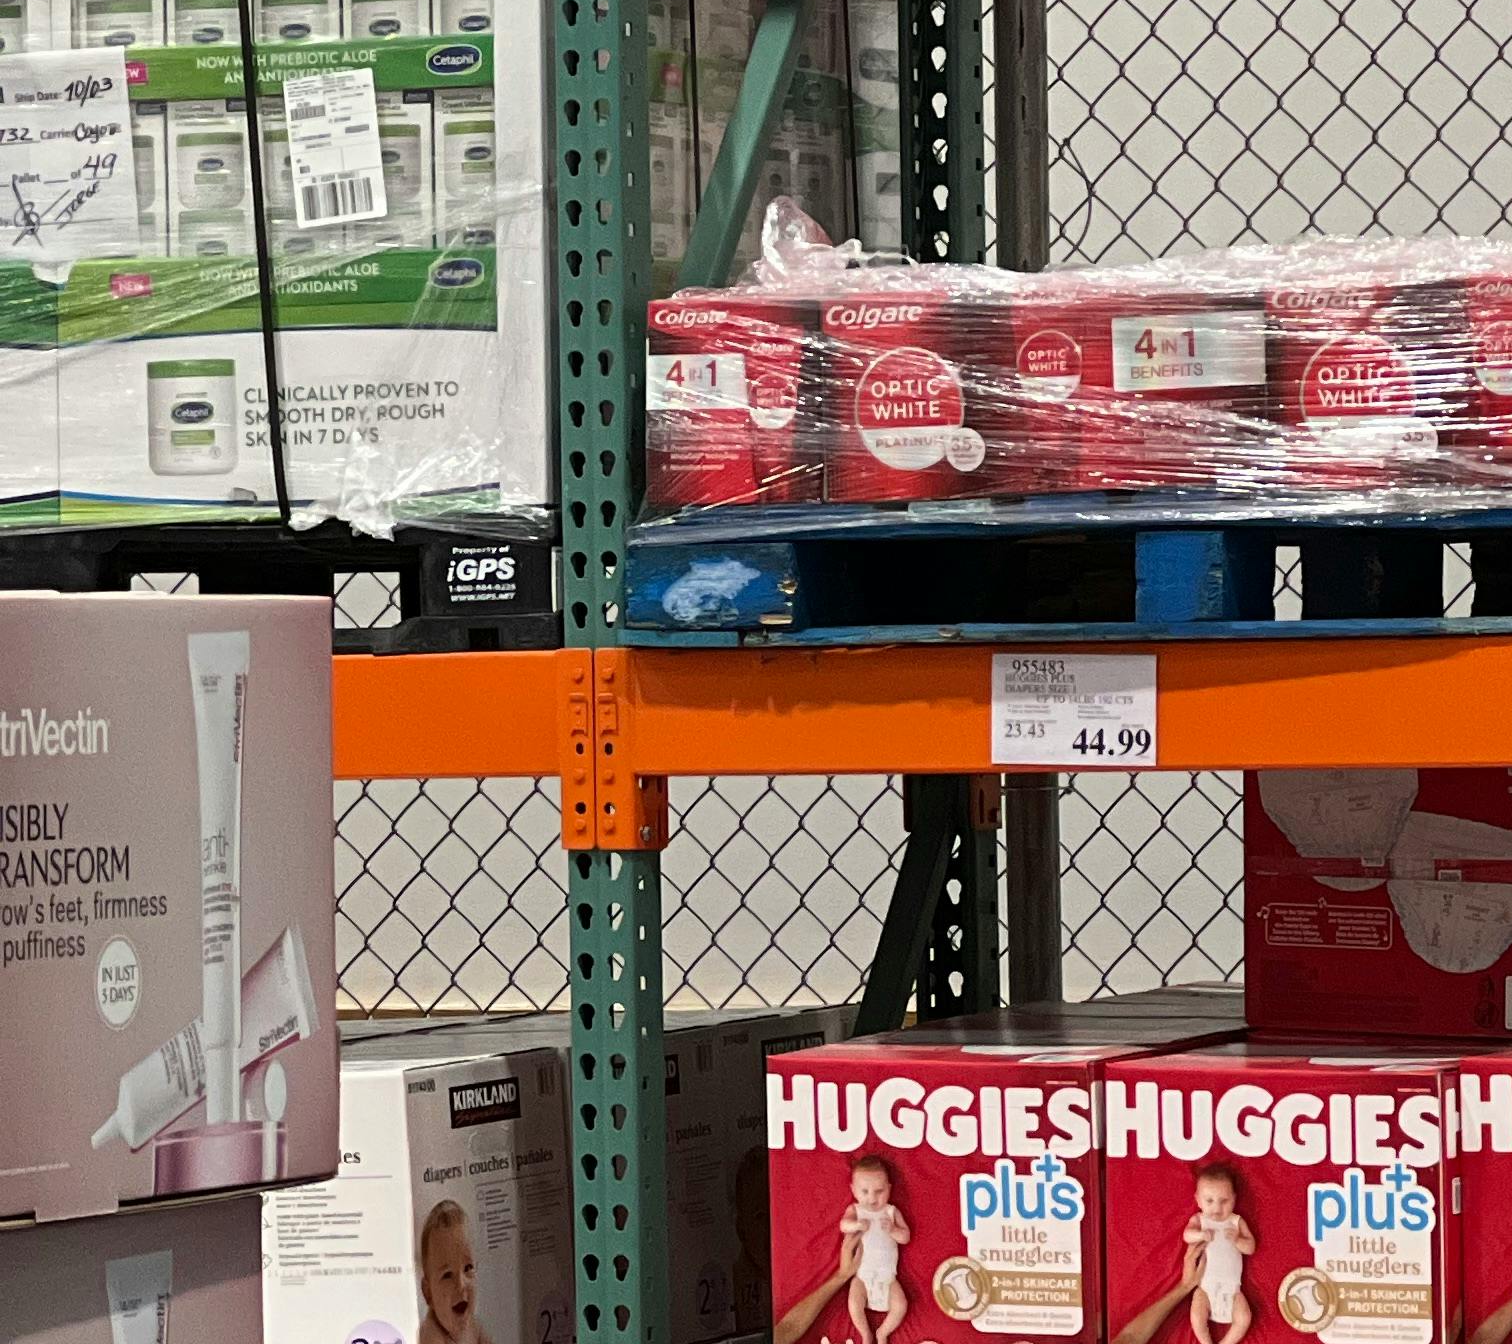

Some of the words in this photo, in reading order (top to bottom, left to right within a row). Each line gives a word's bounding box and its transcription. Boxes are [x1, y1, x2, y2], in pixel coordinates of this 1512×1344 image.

[196, 58, 230, 68] NOW
[274, 52, 339, 65] PREBIOTIC
[342, 50, 377, 62] ALOE
[432, 54, 474, 66] Cetaphil
[654, 310, 728, 331] Colgate
[826, 305, 922, 329] Colgate
[1135, 329, 1157, 358] 4
[1161, 337, 1179, 355] IN
[1182, 330, 1197, 357] 1
[1027, 348, 1066, 360] OPTIC
[1028, 358, 1067, 372] WHITE
[1130, 362, 1203, 379] BENEFITS
[244, 384, 348, 403] CLNICALLY
[354, 382, 429, 399] PROVEN
[434, 381, 459, 396] TO
[871, 380, 940, 397] OPTIC
[332, 405, 370, 423] DRY,
[377, 404, 445, 420] ROUGH
[872, 402, 941, 420] WHITE
[246, 432, 287, 446] SKN
[294, 430, 312, 445] IN
[317, 430, 327, 444] 7
[447, 557, 516, 582] iGPS
[1012, 660, 1065, 674] 955483
[1005, 724, 1045, 738] 23.43
[1072, 728, 1151, 756] 44.99
[49, 895, 89, 928] feet,
[93, 891, 168, 921] firmness
[4, 930, 86, 968] puffiness
[112, 963, 136, 982] JUST
[110, 984, 136, 1003] DAYS
[452, 1081, 517, 1111] KIRKLAND
[767, 1073, 1091, 1159] HUGGIES
[423, 1165, 462, 1186] diapers
[468, 1156, 510, 1176] couches
[516, 1147, 553, 1172] pañales
